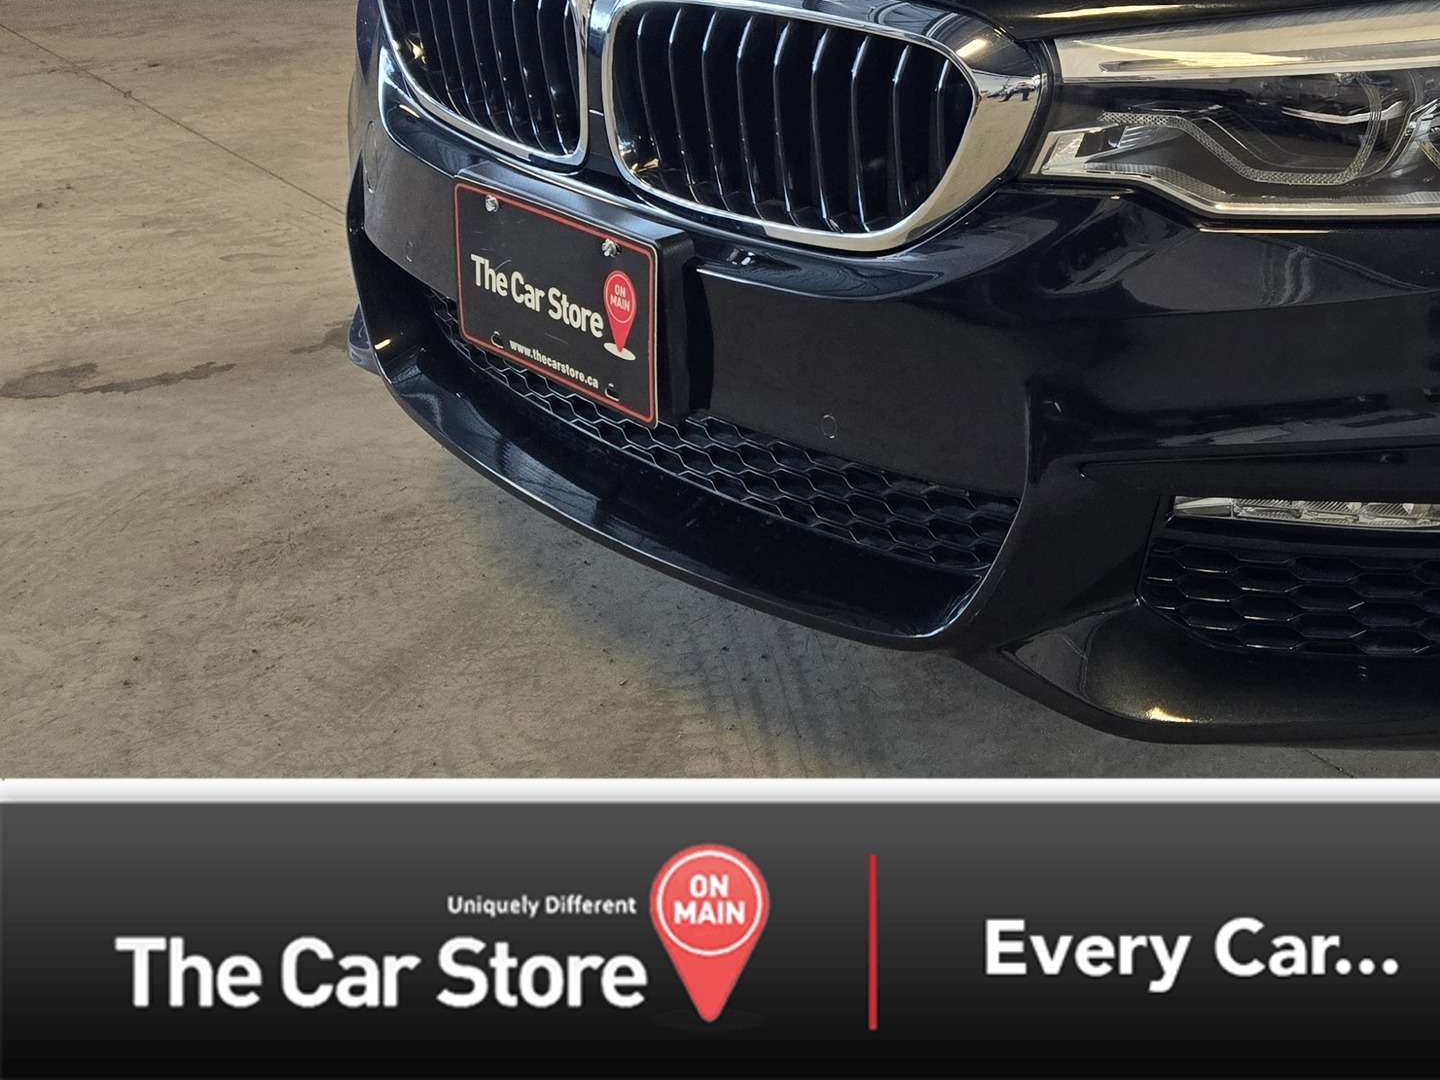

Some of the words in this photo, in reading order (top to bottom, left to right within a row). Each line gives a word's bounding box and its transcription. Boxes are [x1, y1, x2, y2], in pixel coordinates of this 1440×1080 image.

[470, 253, 508, 297] The
[511, 271, 545, 312] Car
[548, 287, 604, 338] Store
[610, 293, 630, 313] MAIN
[614, 283, 626, 298] ON
[509, 340, 599, 389] www.thecarstore.ca
